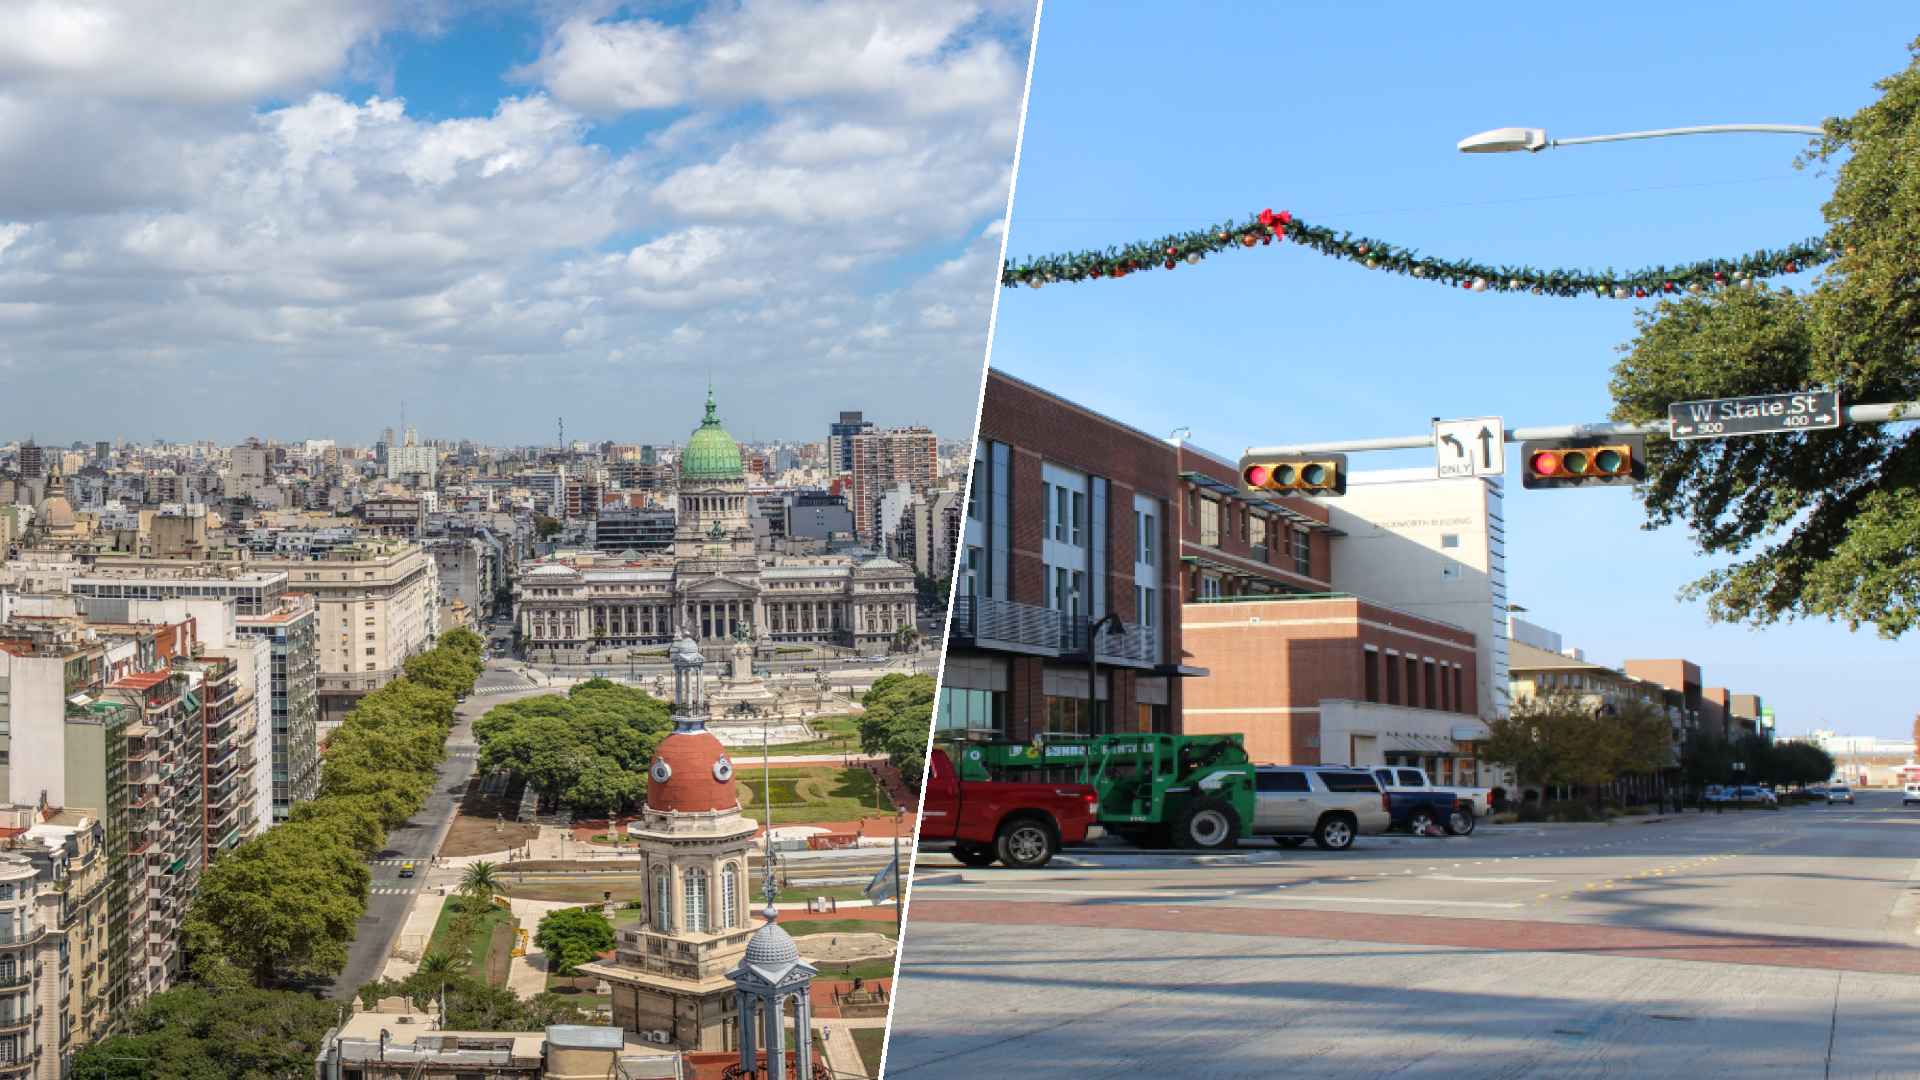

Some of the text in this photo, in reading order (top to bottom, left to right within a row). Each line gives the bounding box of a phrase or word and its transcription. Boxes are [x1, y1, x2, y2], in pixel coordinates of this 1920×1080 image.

[1690, 395, 1817, 422] W State St
[1783, 415, 1810, 426] 400
[1698, 422, 1723, 434] 500
[1440, 463, 1472, 474] ONLY
